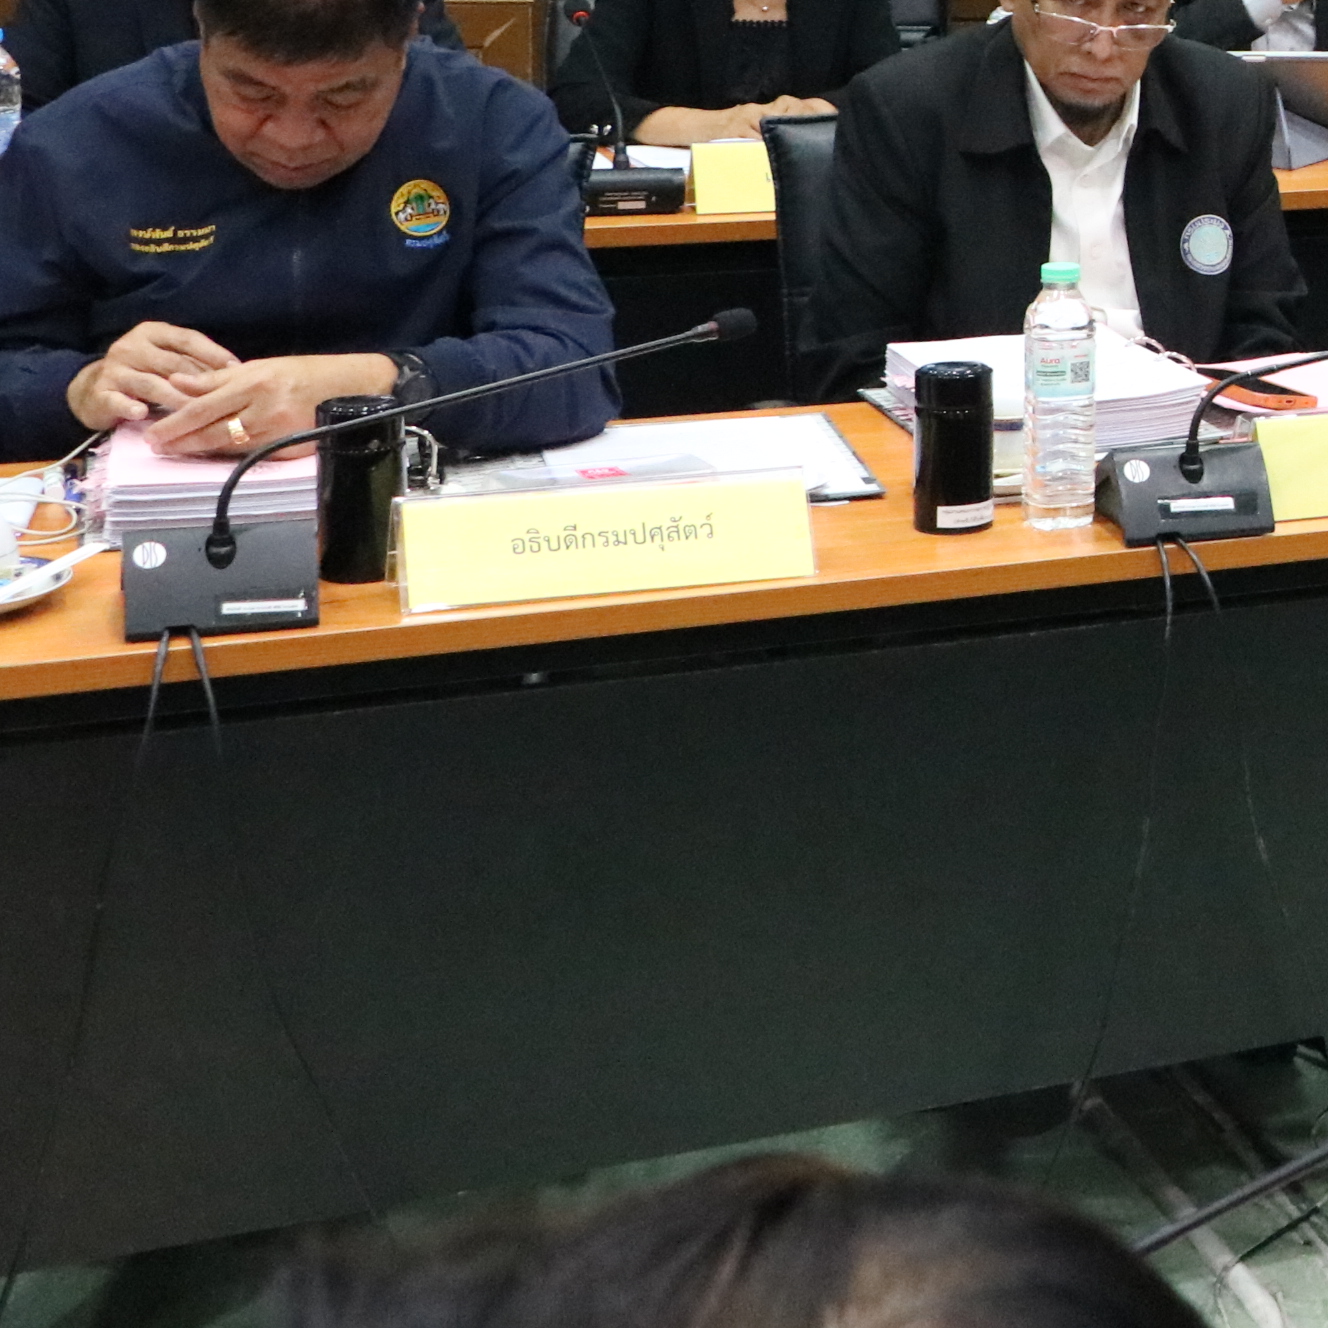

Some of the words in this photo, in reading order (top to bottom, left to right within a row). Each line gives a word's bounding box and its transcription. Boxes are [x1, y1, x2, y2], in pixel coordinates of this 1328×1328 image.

[511, 512, 714, 555] อธิบดีกรมปศุสัตว์
